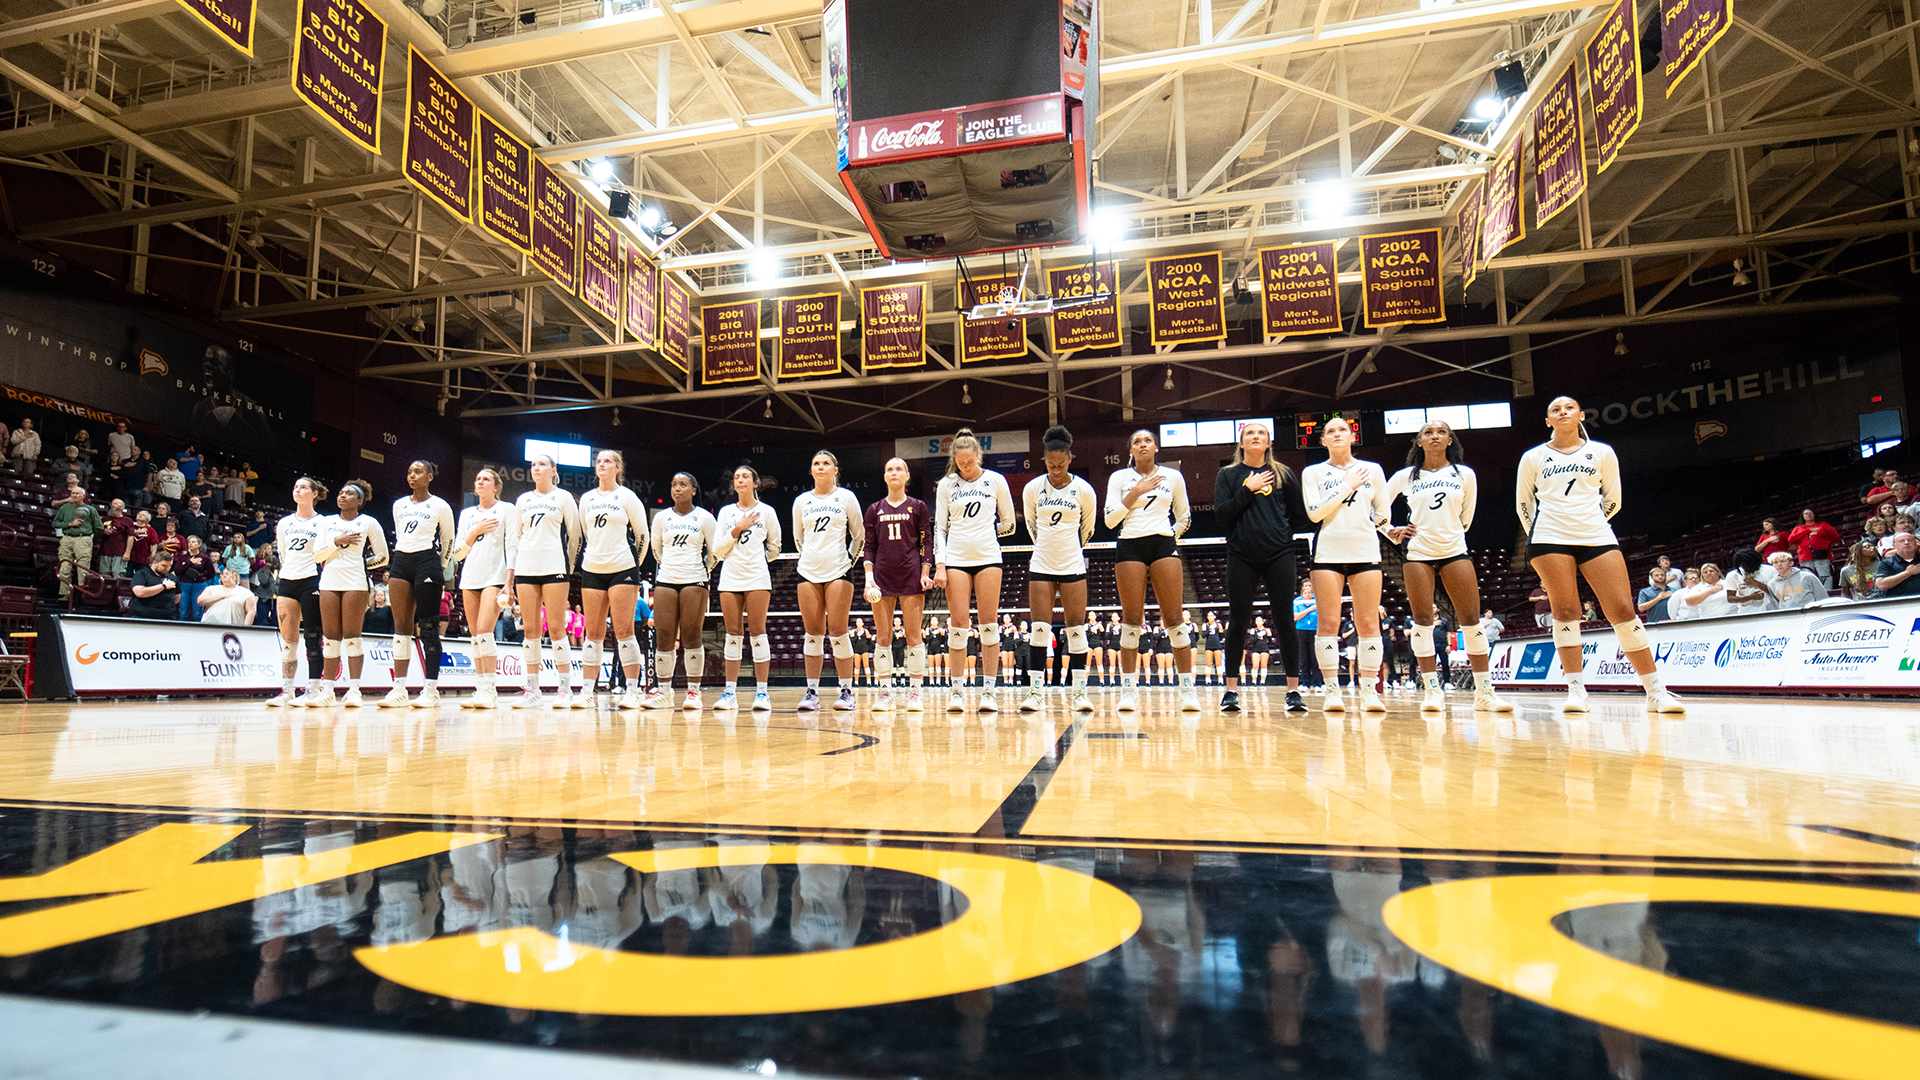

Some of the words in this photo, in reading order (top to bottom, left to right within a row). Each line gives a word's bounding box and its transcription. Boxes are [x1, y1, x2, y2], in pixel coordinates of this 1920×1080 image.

[331, 0, 365, 25] 017
[327, 6, 361, 43] BIG
[1597, 15, 1623, 58] 2008
[310, 12, 376, 77] SOUTH
[302, 26, 379, 95] Champions
[1593, 29, 1630, 85] NCAA
[1602, 57, 1624, 92] East
[319, 74, 358, 112] Men's
[429, 77, 459, 110] 2010
[1595, 60, 1634, 118] Regional
[302, 73, 372, 136] Basketball
[1543, 83, 1567, 119] 2007
[430, 95, 456, 124] BIG
[417, 101, 469, 152] SOUTH
[965, 118, 994, 132] JOIN
[997, 114, 1022, 127] THE
[1539, 96, 1574, 144] NCAA
[1607, 104, 1627, 135] Men's
[871, 119, 944, 152] Coca-Cola
[965, 126, 1014, 143] EAGLE
[1017, 119, 1058, 135] CLUB
[494, 133, 518, 158] 2008
[496, 150, 517, 172] BIG
[425, 158, 456, 189] Men's
[486, 161, 527, 197] SOUTH
[411, 160, 467, 208] Basketball
[1549, 168, 1575, 195] Men's
[483, 174, 529, 211] Champions
[546, 192, 565, 214] BIG
[495, 207, 519, 228] Men's
[538, 198, 573, 236] SOUTH
[485, 211, 529, 244] Basketball
[594, 233, 610, 252] BIG
[1379, 239, 1422, 254] 2002
[587, 240, 617, 271] SOUTH
[1278, 251, 1318, 266] 2001
[1371, 252, 1431, 269] NCAA
[31, 258, 56, 277] 122
[1166, 262, 1203, 276] 2000
[1270, 263, 1328, 280] NCAA
[1379, 266, 1426, 280] South
[629, 276, 654, 303] SOUTH
[1158, 274, 1213, 290] NCAA
[1268, 277, 1331, 292] Midwest
[1370, 277, 1436, 293] Regional
[1167, 289, 1205, 300] West
[1269, 288, 1332, 303] Regional
[795, 301, 824, 313] 2000
[881, 303, 906, 314] BIG
[1157, 297, 1217, 312] Regional
[1385, 299, 1421, 309] Men's
[718, 309, 744, 320] 2001
[798, 313, 821, 324] BIG
[869, 314, 918, 326] SOUTH
[1057, 306, 1114, 321] Regional
[1284, 309, 1319, 319] Men's
[1372, 305, 1437, 320] Basketball
[719, 321, 742, 331] BIG
[786, 323, 834, 335] SOUTH
[1171, 318, 1205, 328] Men's
[1272, 316, 1334, 328] Basketball
[709, 330, 753, 343] SOUTH
[865, 325, 921, 337] Champions
[1071, 325, 1102, 336] Men's
[1159, 324, 1219, 337] Basketball
[238, 338, 254, 353] 121
[782, 334, 836, 345] Champions
[979, 336, 1009, 345] Men's
[1059, 332, 1115, 345] Basketball
[5, 324, 128, 371] WINTHROP
[706, 342, 756, 353] Champions
[879, 344, 908, 353] Men's
[968, 341, 1021, 354] Basketball
[718, 359, 744, 368] Men's
[795, 353, 823, 361] Men's
[868, 351, 920, 362] Basketball
[708, 365, 755, 377] Basketball
[784, 359, 835, 370] Basketball
[1689, 359, 1712, 372] 112
[1583, 355, 1865, 428] ROCKTHEHILL
[176, 379, 284, 420] BASKETBALL
[1306, 426, 1313, 435] 0
[1352, 423, 1360, 432] 0
[382, 431, 398, 446] 120
[1301, 437, 1308, 446] 0
[1023, 460, 1031, 470] 6
[1104, 455, 1121, 465] 115
[1541, 463, 1597, 479] Winthrop
[1411, 480, 1461, 494] Winthrop
[1564, 478, 1576, 496] 1
[950, 489, 991, 502] Winthrop
[1143, 495, 1157, 511] 7
[1341, 490, 1358, 507] 4
[1429, 492, 1446, 510] 3
[963, 501, 981, 518] 10
[1037, 497, 1077, 510] Winthrop
[803, 505, 842, 518] Winthrop
[880, 513, 910, 522] WINTHROP
[1049, 511, 1063, 526] 9
[404, 520, 418, 534] 19
[529, 513, 545, 528] 17
[594, 513, 608, 528] 16
[813, 516, 831, 533] 12
[887, 523, 902, 540] 11
[288, 538, 308, 551] 23
[672, 534, 689, 547] 14
[1740, 636, 1757, 648] York
[1758, 635, 1790, 649] County
[1805, 631, 1851, 644] STURGIS
[1853, 628, 1895, 641] BEATY
[1676, 641, 1710, 653] Williams
[1734, 647, 1766, 660] Natural
[1766, 647, 1783, 659] Gas
[102, 649, 181, 664] comporium
[1804, 653, 1879, 665] Auto-Owners
[199, 660, 276, 677] FOUNDERS
[1597, 660, 1637, 675] FOUNDERS
